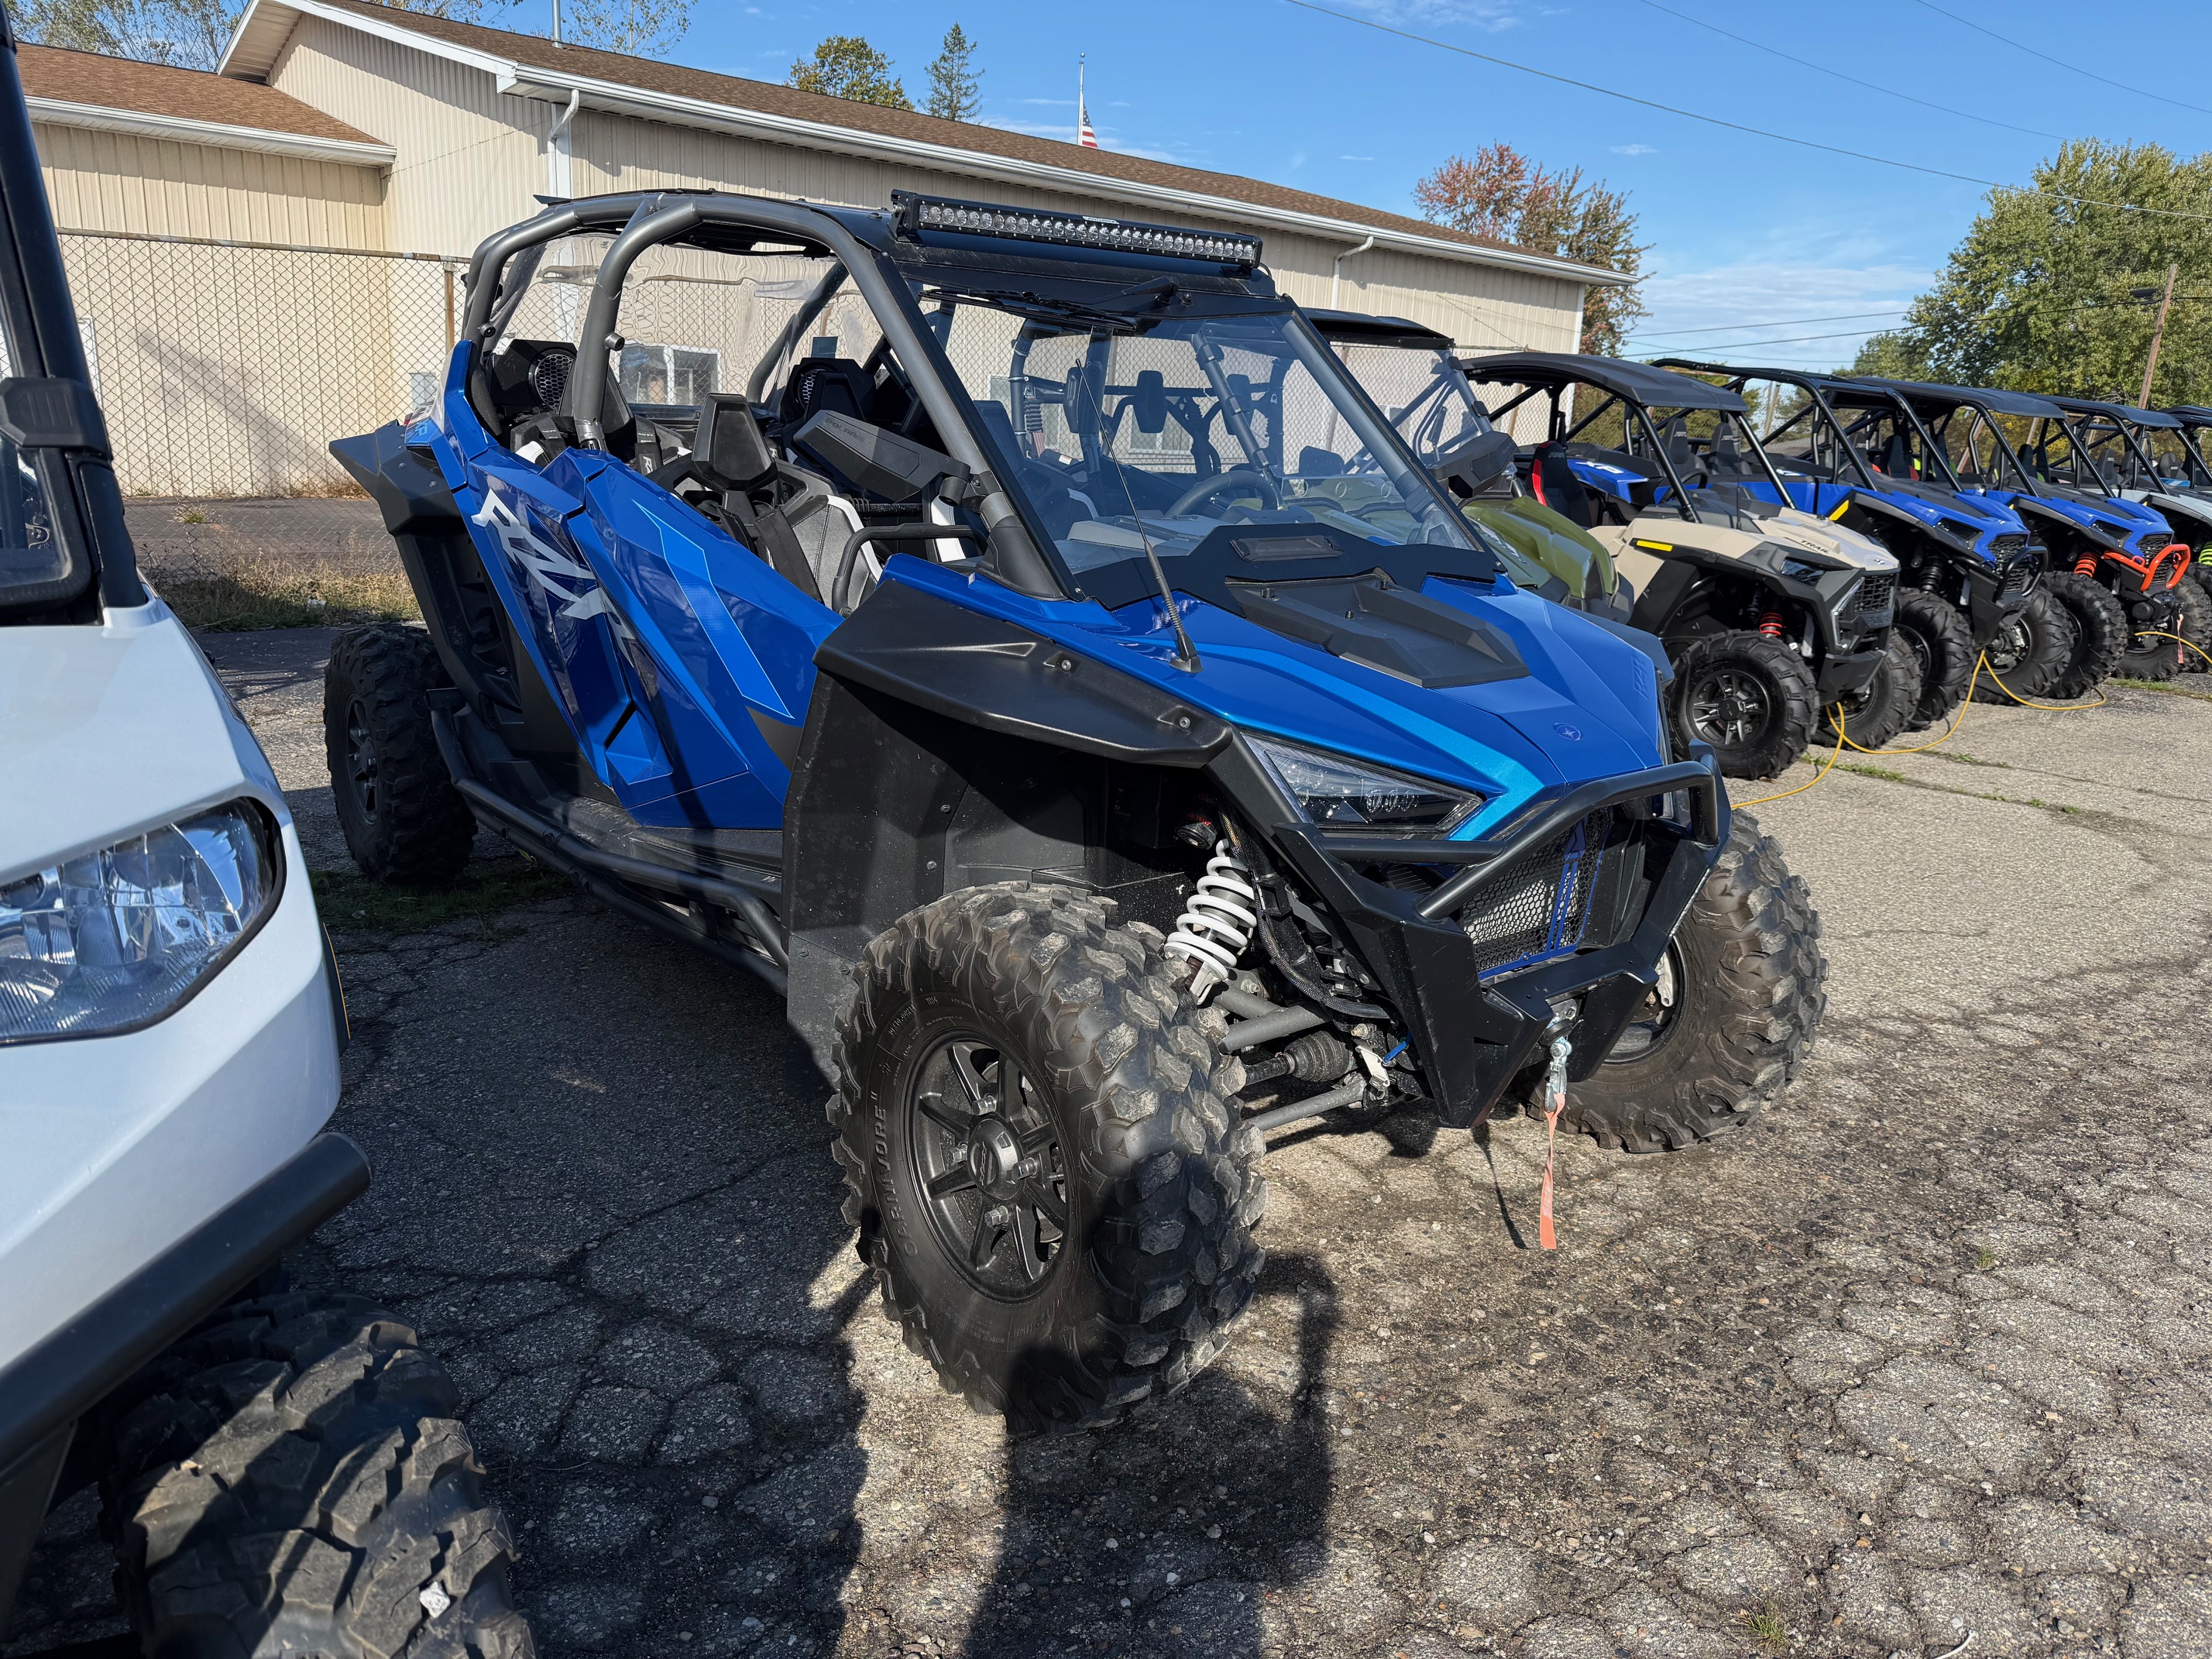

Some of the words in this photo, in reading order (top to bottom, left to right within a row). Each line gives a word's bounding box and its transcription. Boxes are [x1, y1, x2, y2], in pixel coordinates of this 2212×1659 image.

[825, 418, 865, 444] POLARIS
[471, 489, 637, 668] RZR
[1801, 540, 1829, 554] TRAIL
[874, 1104, 919, 1258] CARNIVORE
